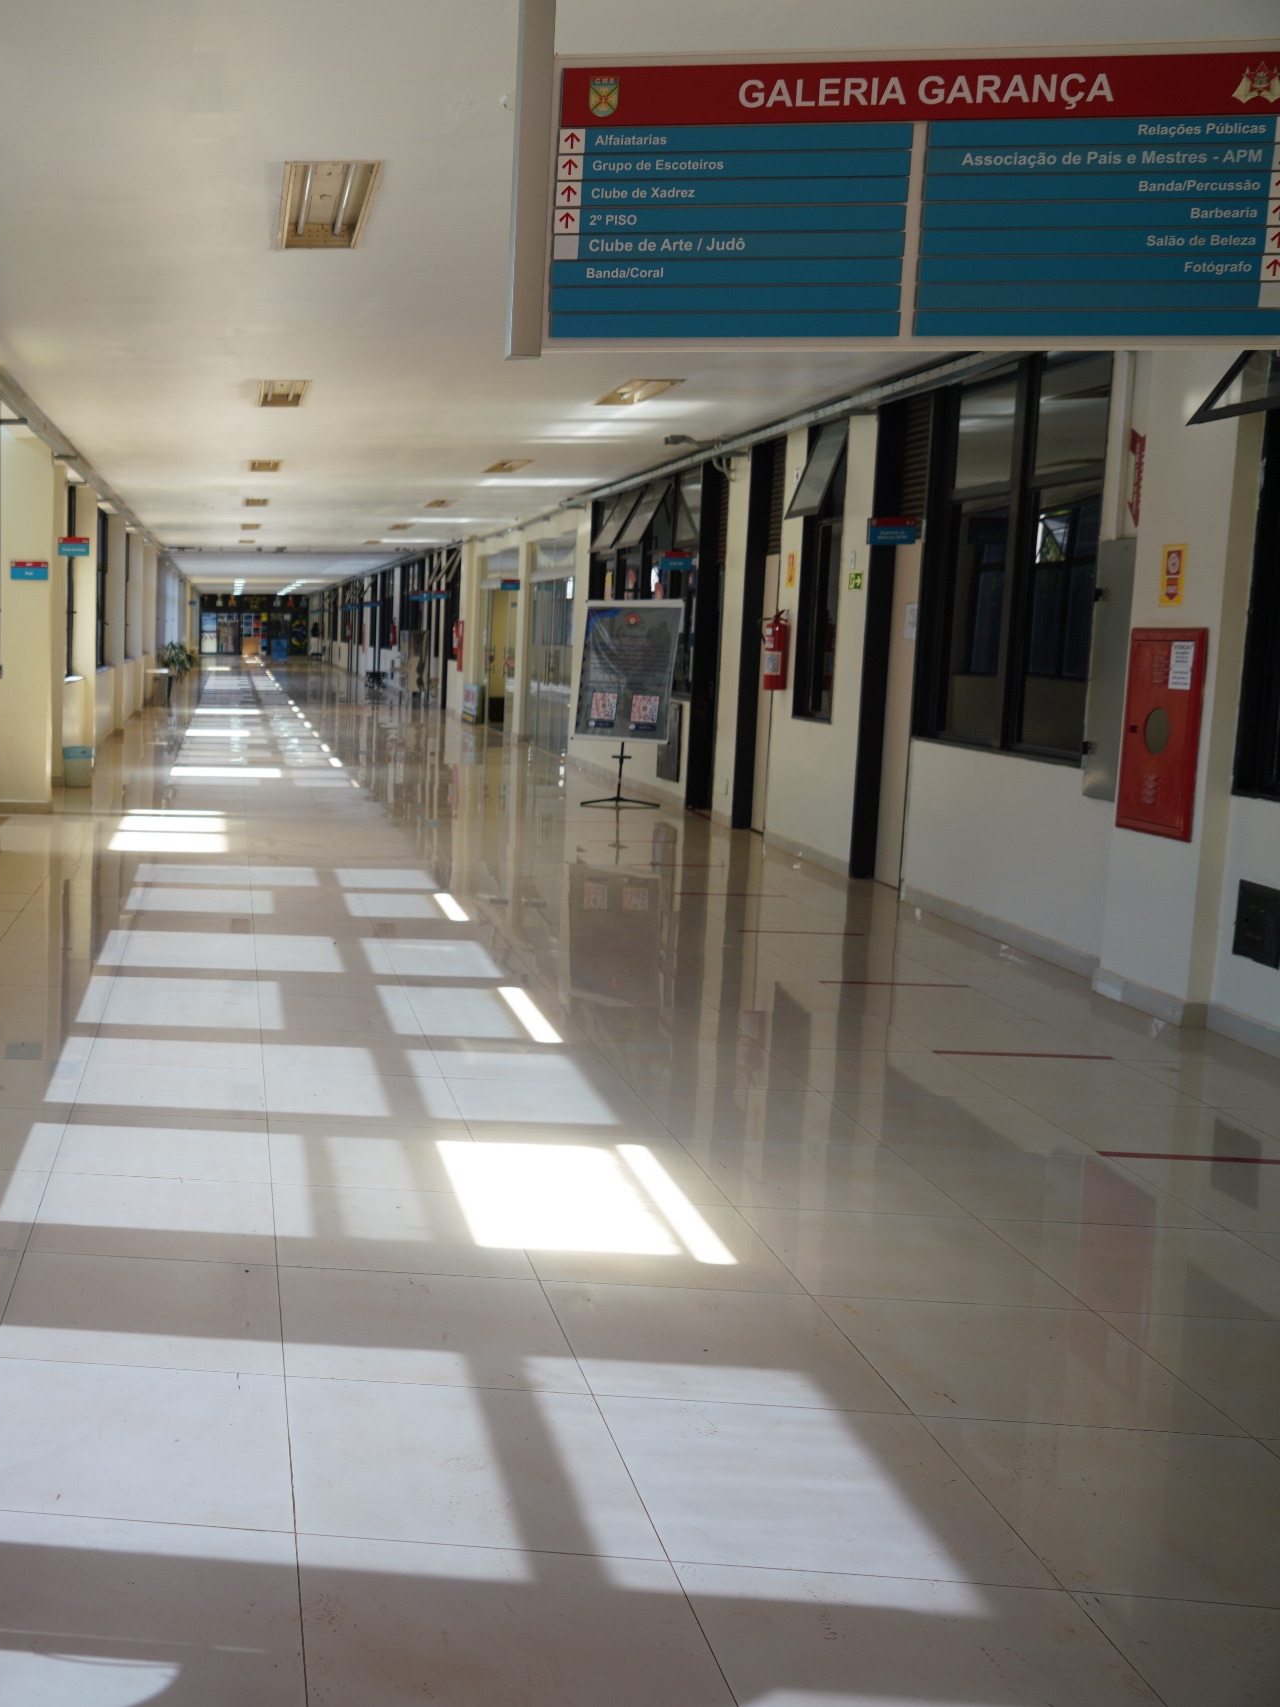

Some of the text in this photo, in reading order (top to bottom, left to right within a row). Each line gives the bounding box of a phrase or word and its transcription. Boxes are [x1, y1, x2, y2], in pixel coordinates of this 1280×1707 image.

[738, 73, 1114, 110] GALERIA GARANÇA
[1138, 122, 1267, 138] Relações Públicas
[595, 134, 667, 146] Alfaiatarias
[962, 152, 1057, 168] Associação
[1061, 152, 1082, 165] de
[1086, 151, 1122, 165] Pais
[1127, 154, 1137, 164] e
[1141, 151, 1208, 164] Mestres
[1223, 149, 1262, 163] APM
[592, 159, 724, 173] Grupo de Escoteiros
[1138, 179, 1261, 192] Banda/Percussão
[591, 187, 695, 199] Clube de Xadrez
[1190, 207, 1258, 219] Barbearia
[606, 214, 637, 226] PISO
[589, 239, 633, 252] Clube
[638, 239, 656, 252] de
[660, 239, 693, 252] Arte
[706, 237, 745, 252] Judô
[1146, 234, 1256, 247] Salão de Beleza
[586, 267, 664, 279] Banda/Coral
[1184, 260, 1252, 275] Fotógrafo
